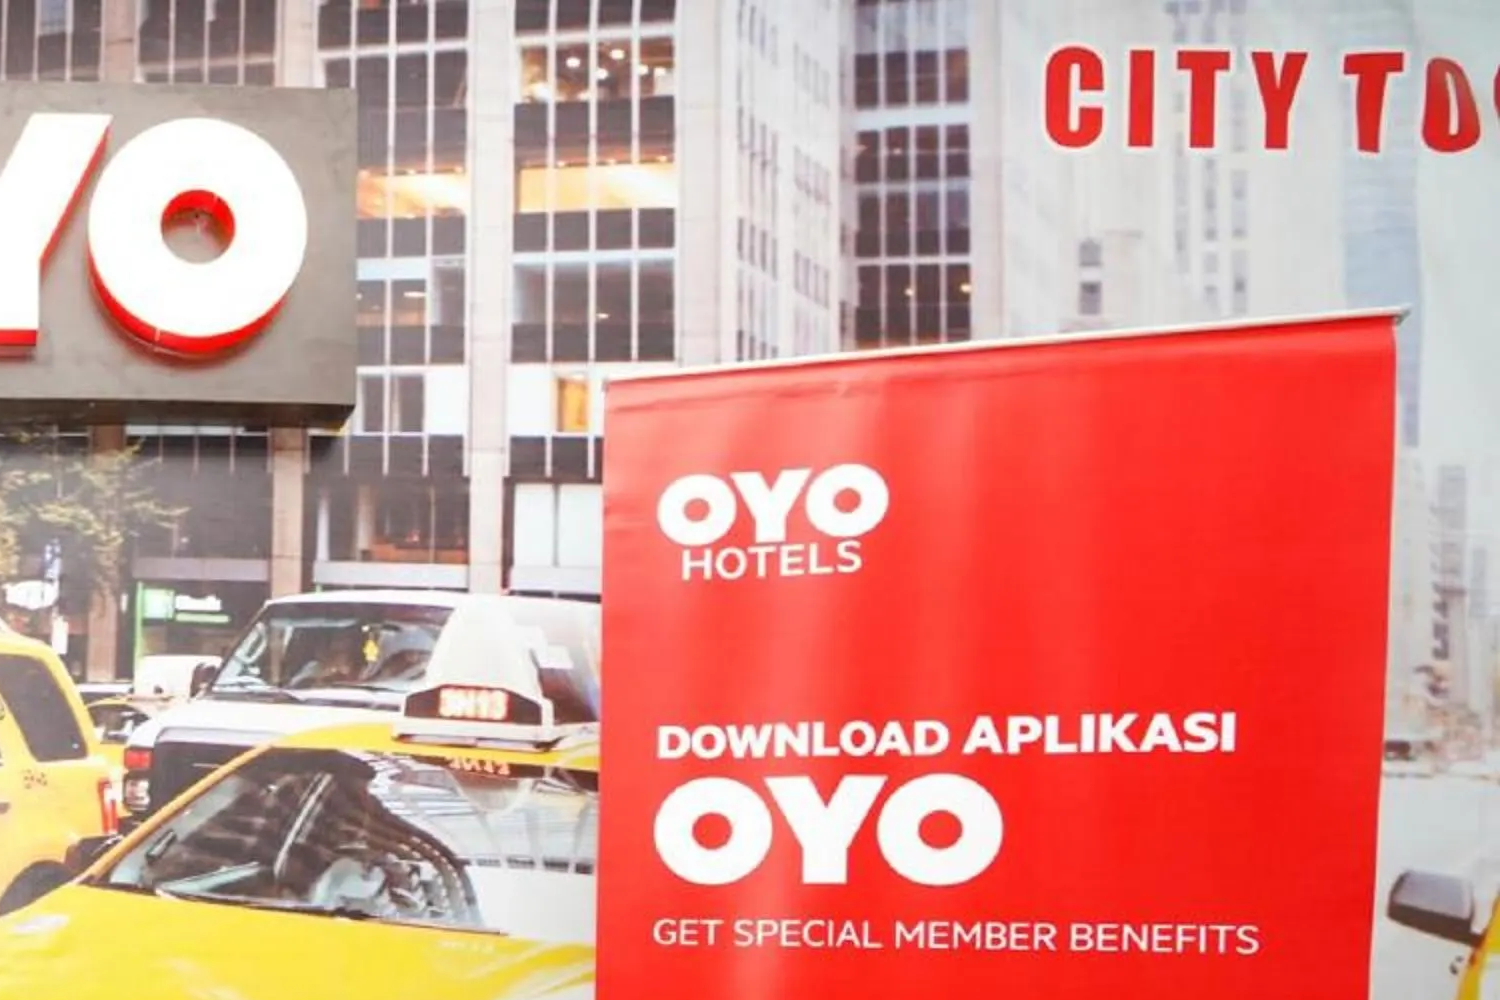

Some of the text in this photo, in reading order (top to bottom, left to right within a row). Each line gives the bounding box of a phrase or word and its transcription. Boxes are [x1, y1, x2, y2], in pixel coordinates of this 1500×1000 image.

[1044, 46, 1500, 153] CITY TO
[657, 463, 889, 546] OYO
[681, 540, 862, 581] HOTELS
[657, 711, 1236, 759] DOWNLOAD APLIKASI
[653, 773, 1003, 886] OYO
[653, 919, 1260, 954] GET SPECIAL MEMBER BENEFITS
